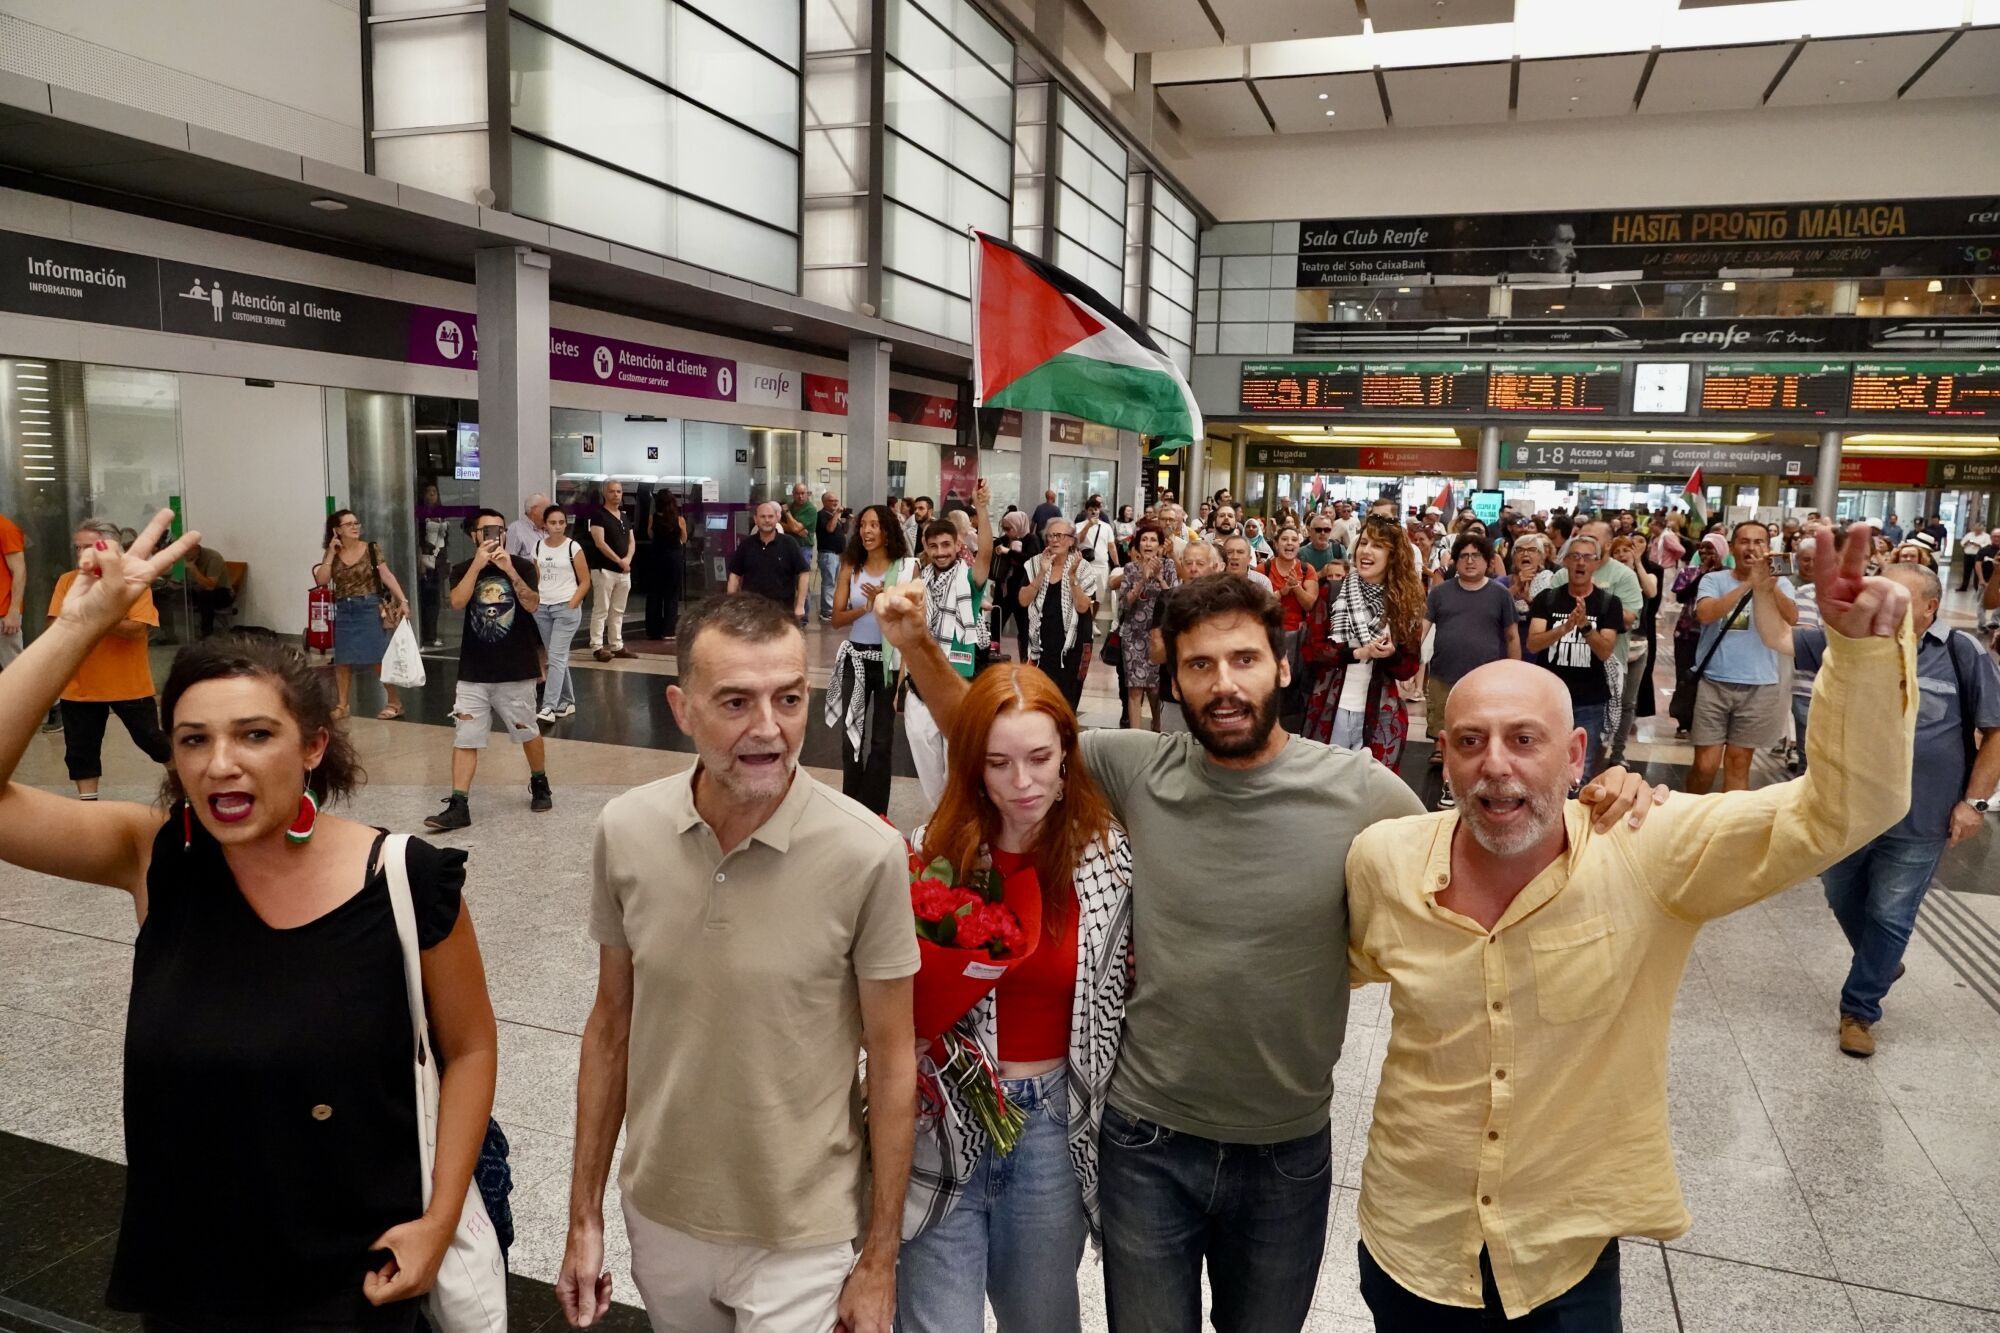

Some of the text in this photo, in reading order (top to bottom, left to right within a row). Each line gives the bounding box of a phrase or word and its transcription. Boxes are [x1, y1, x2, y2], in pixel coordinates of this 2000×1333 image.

[1612, 203, 1906, 243] HASTA PRONTO MÁLAGA
[1303, 227, 1429, 248] Sala Club Renfe
[28, 257, 126, 289] Información
[1301, 259, 1426, 271] Teatro del Soho CaixaBank
[1320, 272, 1404, 283] Antonio Banderas
[29, 282, 83, 298] INFORMATION
[232, 290, 342, 322] Atención al Cliente
[232, 311, 286, 327] CUSTOMER SERVICE
[1680, 324, 1750, 350] renfe
[549, 337, 580, 358] letes
[618, 350, 708, 377] Atención al cliente
[618, 371, 669, 387] Customer service
[754, 372, 790, 399] renfe
[834, 385, 848, 408] iry
[938, 403, 952, 423] iryo
[953, 451, 966, 470] iryo
[1273, 449, 1307, 459] Llegadas
[1383, 452, 1394, 460] No
[1536, 447, 1564, 464] 1-8
[1570, 448, 1635, 458] Acceso a vías
[1672, 449, 1782, 462] Control de equipajes
[1556, 642, 1569, 666] AL
